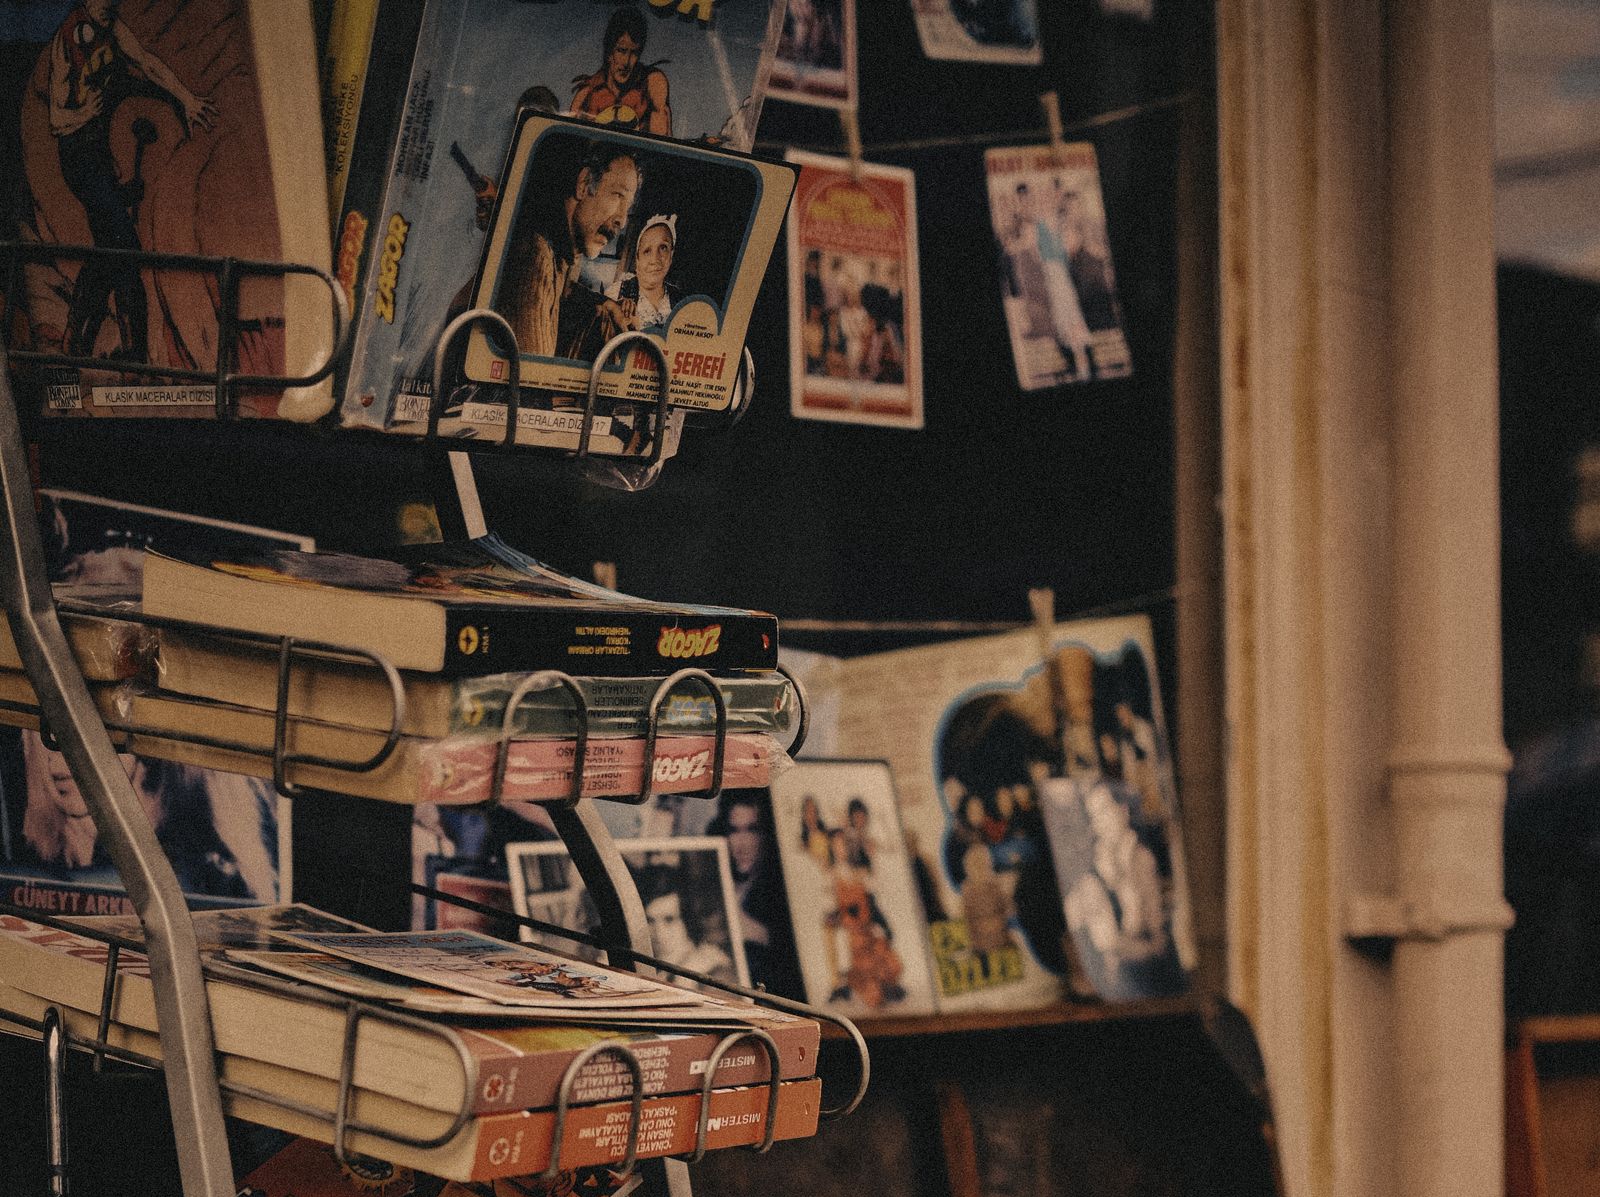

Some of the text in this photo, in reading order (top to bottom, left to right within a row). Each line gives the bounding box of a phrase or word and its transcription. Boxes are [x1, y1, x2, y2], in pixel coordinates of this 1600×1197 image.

[375, 212, 411, 325] ZAGOR
[674, 328, 715, 339] ORHAN AKSOY
[105, 389, 215, 404] KLASİK MACERALAR DİZİSİ
[470, 408, 506, 423] KLASİK
[514, 412, 567, 428] ACERALAR
[657, 623, 723, 660] ZAGOR
[13, 880, 80, 912] CÜNEYT
[720, 1112, 762, 1128] MISTER
